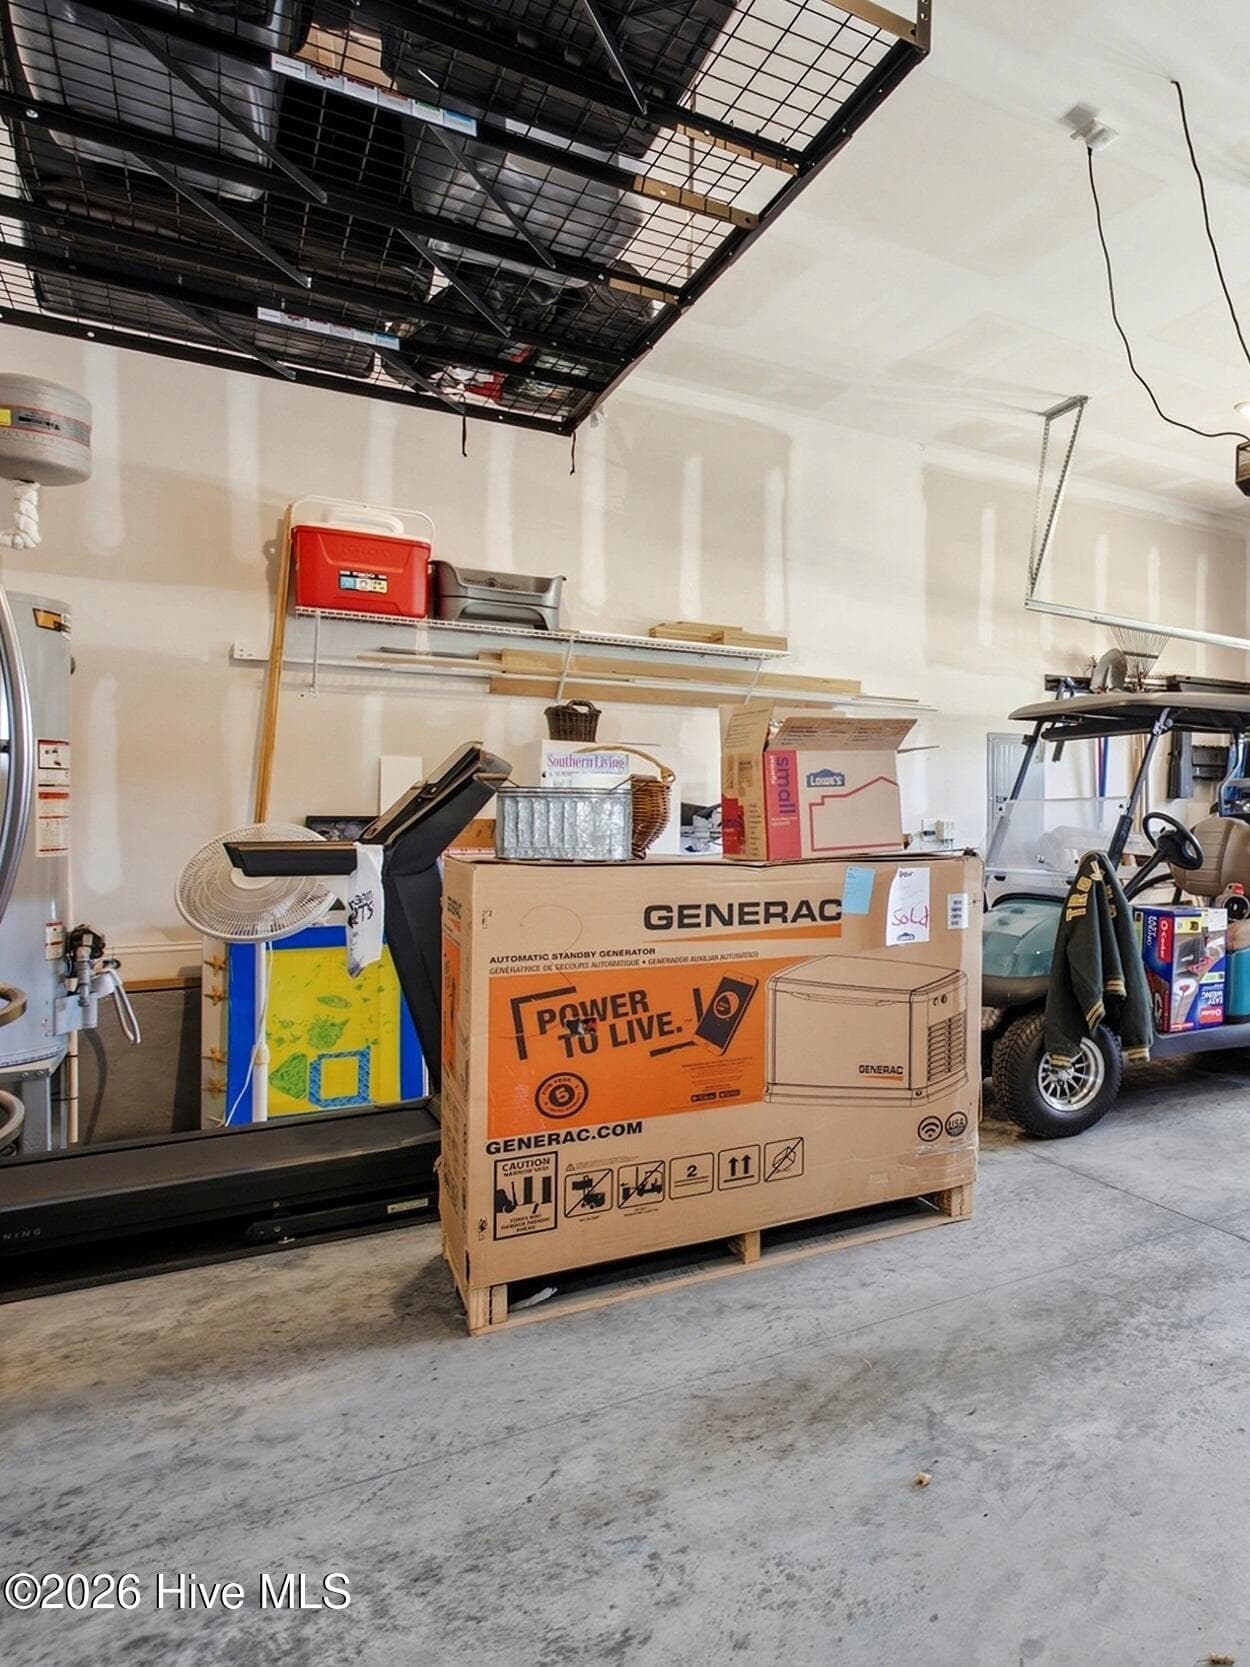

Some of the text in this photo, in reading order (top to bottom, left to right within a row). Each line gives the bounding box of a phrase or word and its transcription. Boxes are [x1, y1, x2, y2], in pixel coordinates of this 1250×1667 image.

[547, 753, 625, 769] Southern Living
[776, 756, 796, 814] small
[643, 899, 843, 931] GENERAC
[891, 905, 929, 928] Sold
[489, 947, 656, 964] AUTOMATIC STANDBY GENERATOR
[536, 989, 650, 1035] POWER
[557, 1011, 683, 1059] TO LIVE.
[858, 1065, 904, 1075] GENERAC
[555, 1088, 569, 1102] 5
[948, 1117, 964, 1129] USA
[486, 1121, 643, 1155] GENERAC.COM
[502, 1157, 550, 1171] CAUTION
[687, 1165, 697, 1178] 2
